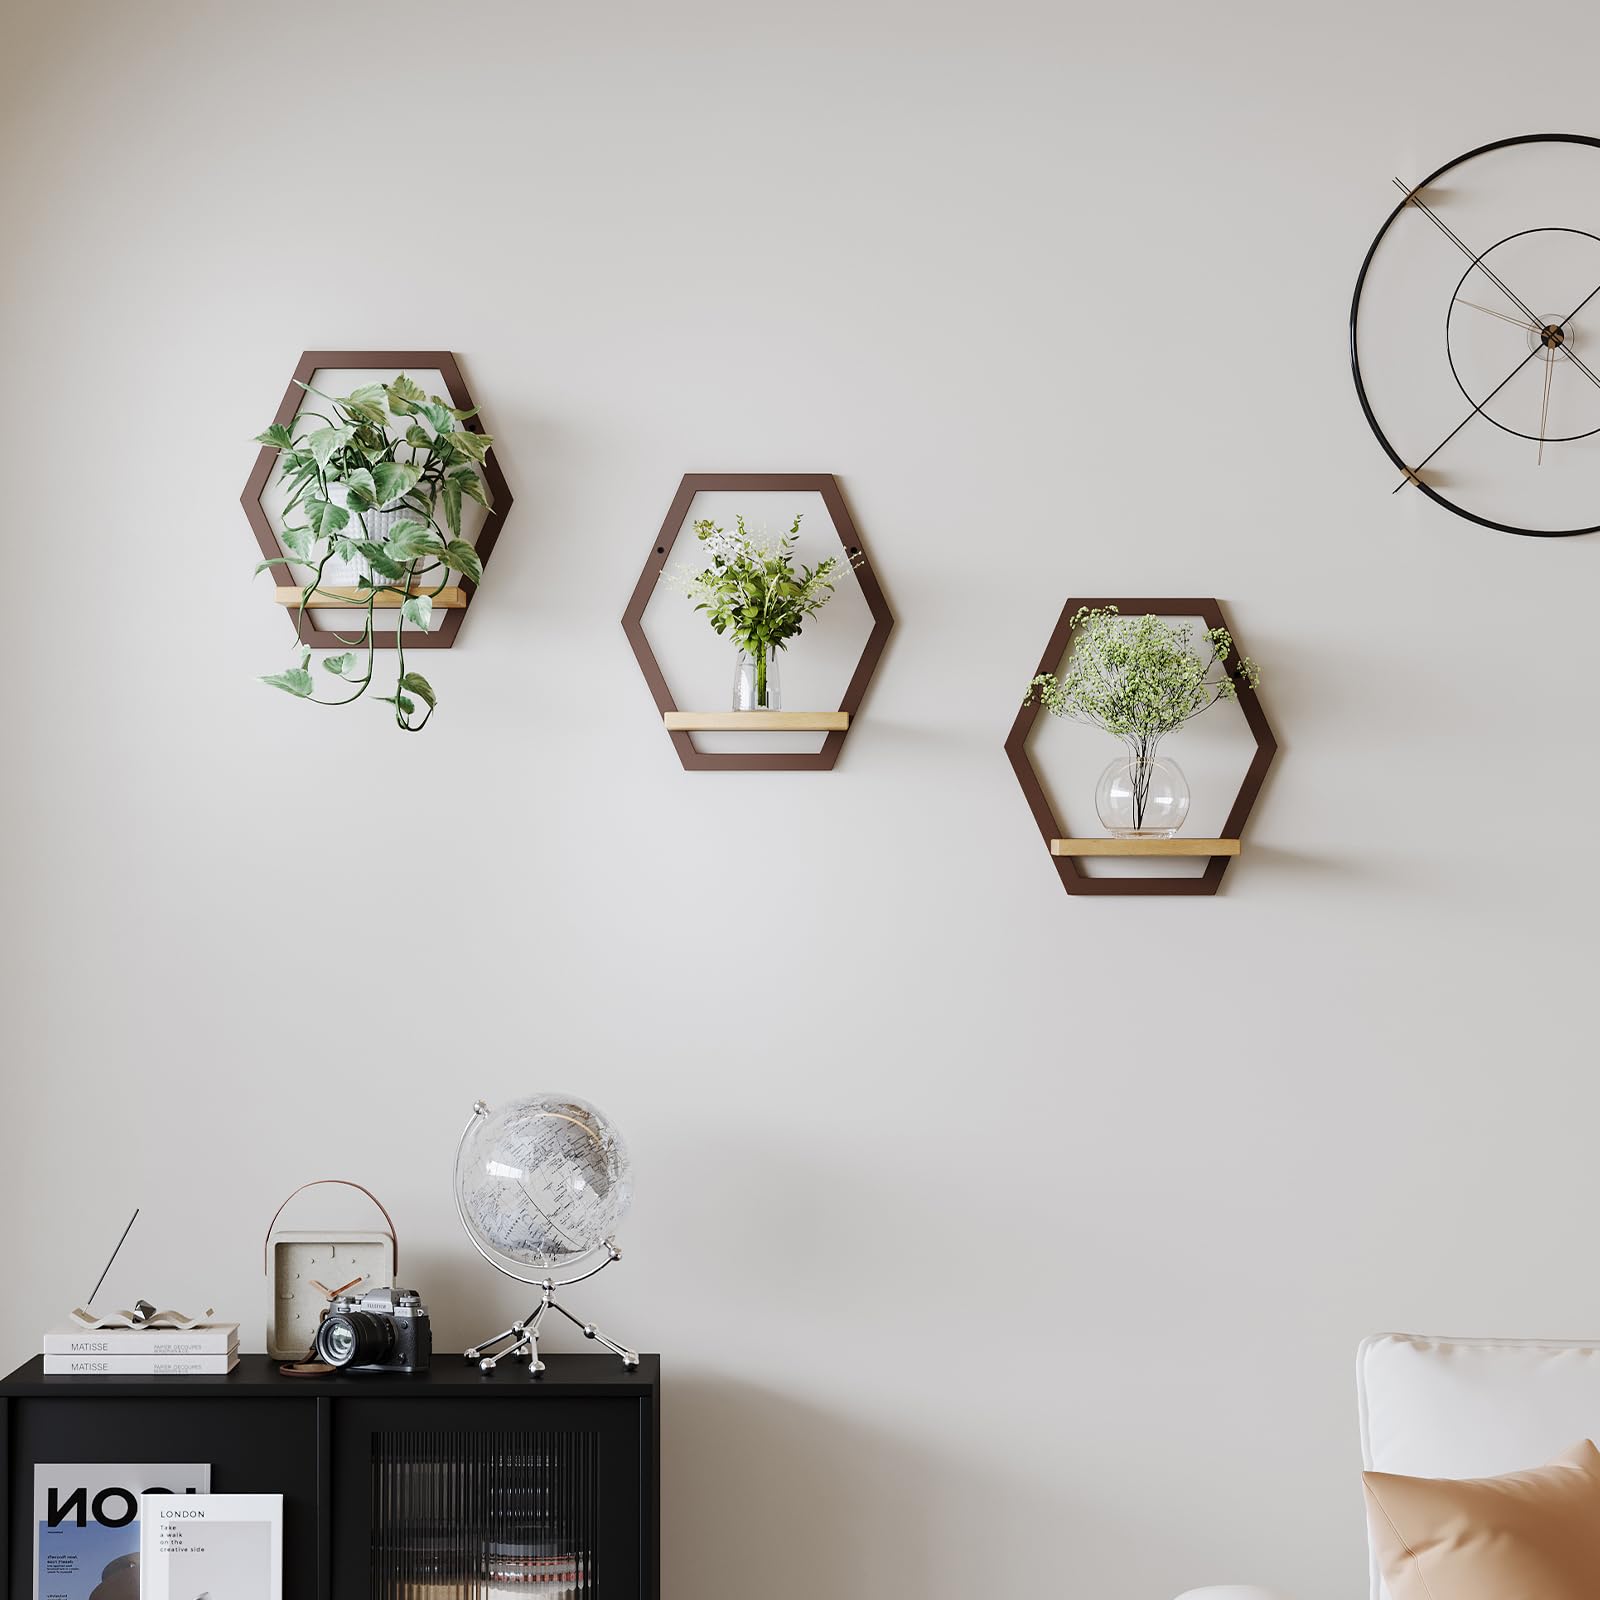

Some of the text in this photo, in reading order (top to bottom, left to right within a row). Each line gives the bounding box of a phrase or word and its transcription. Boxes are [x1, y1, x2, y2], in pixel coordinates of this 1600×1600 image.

[71, 1343, 108, 1351] MATISSE
[71, 1362, 108, 1371] MATISSE
[160, 1510, 205, 1518] LONDON
